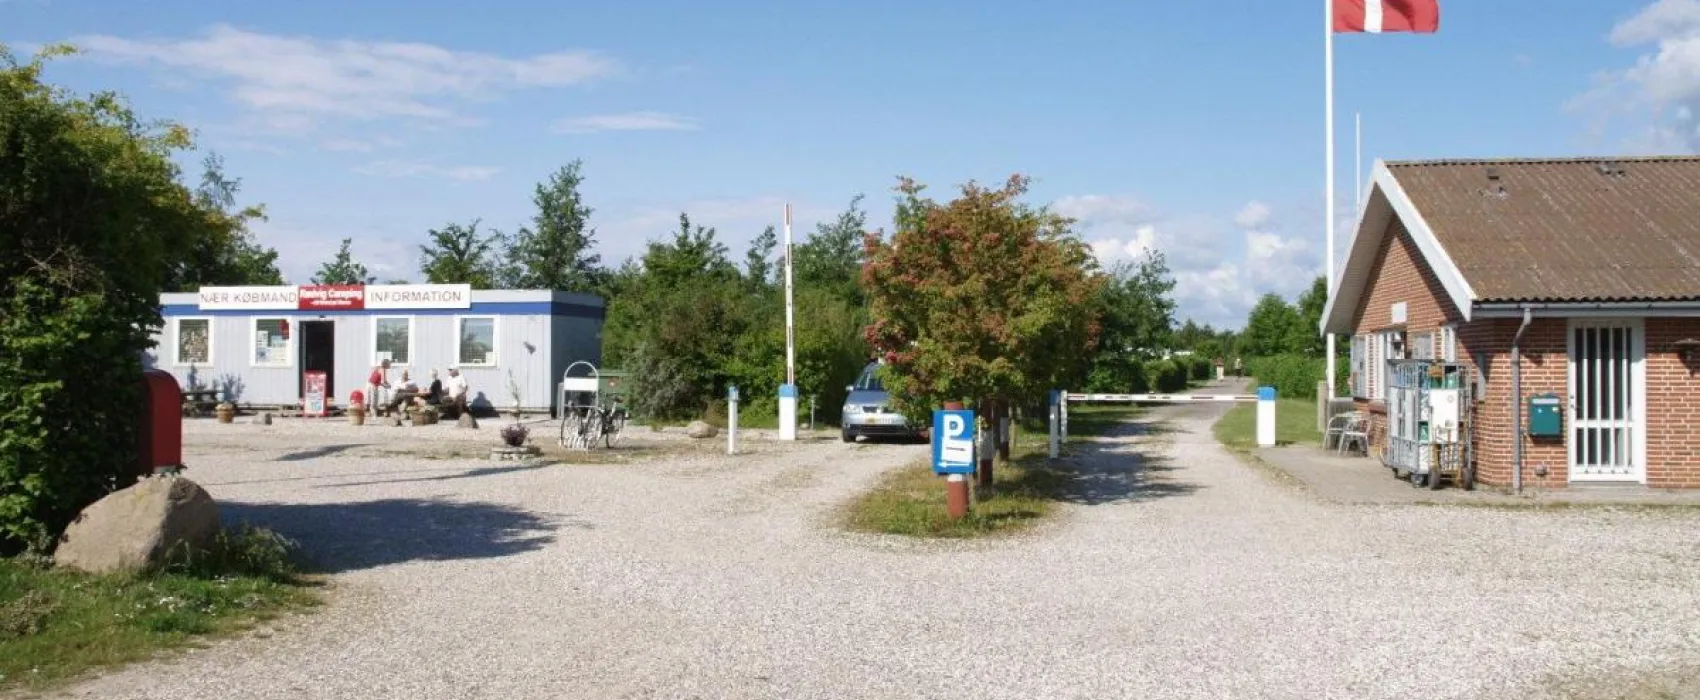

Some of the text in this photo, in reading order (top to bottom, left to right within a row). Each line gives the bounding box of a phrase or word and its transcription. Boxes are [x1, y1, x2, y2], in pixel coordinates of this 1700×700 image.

[200, 292, 229, 303] NÆR
[234, 291, 297, 303] KØBMAND
[328, 287, 363, 301] Camping
[370, 290, 462, 302] INFORMATION
[943, 413, 965, 440] P
